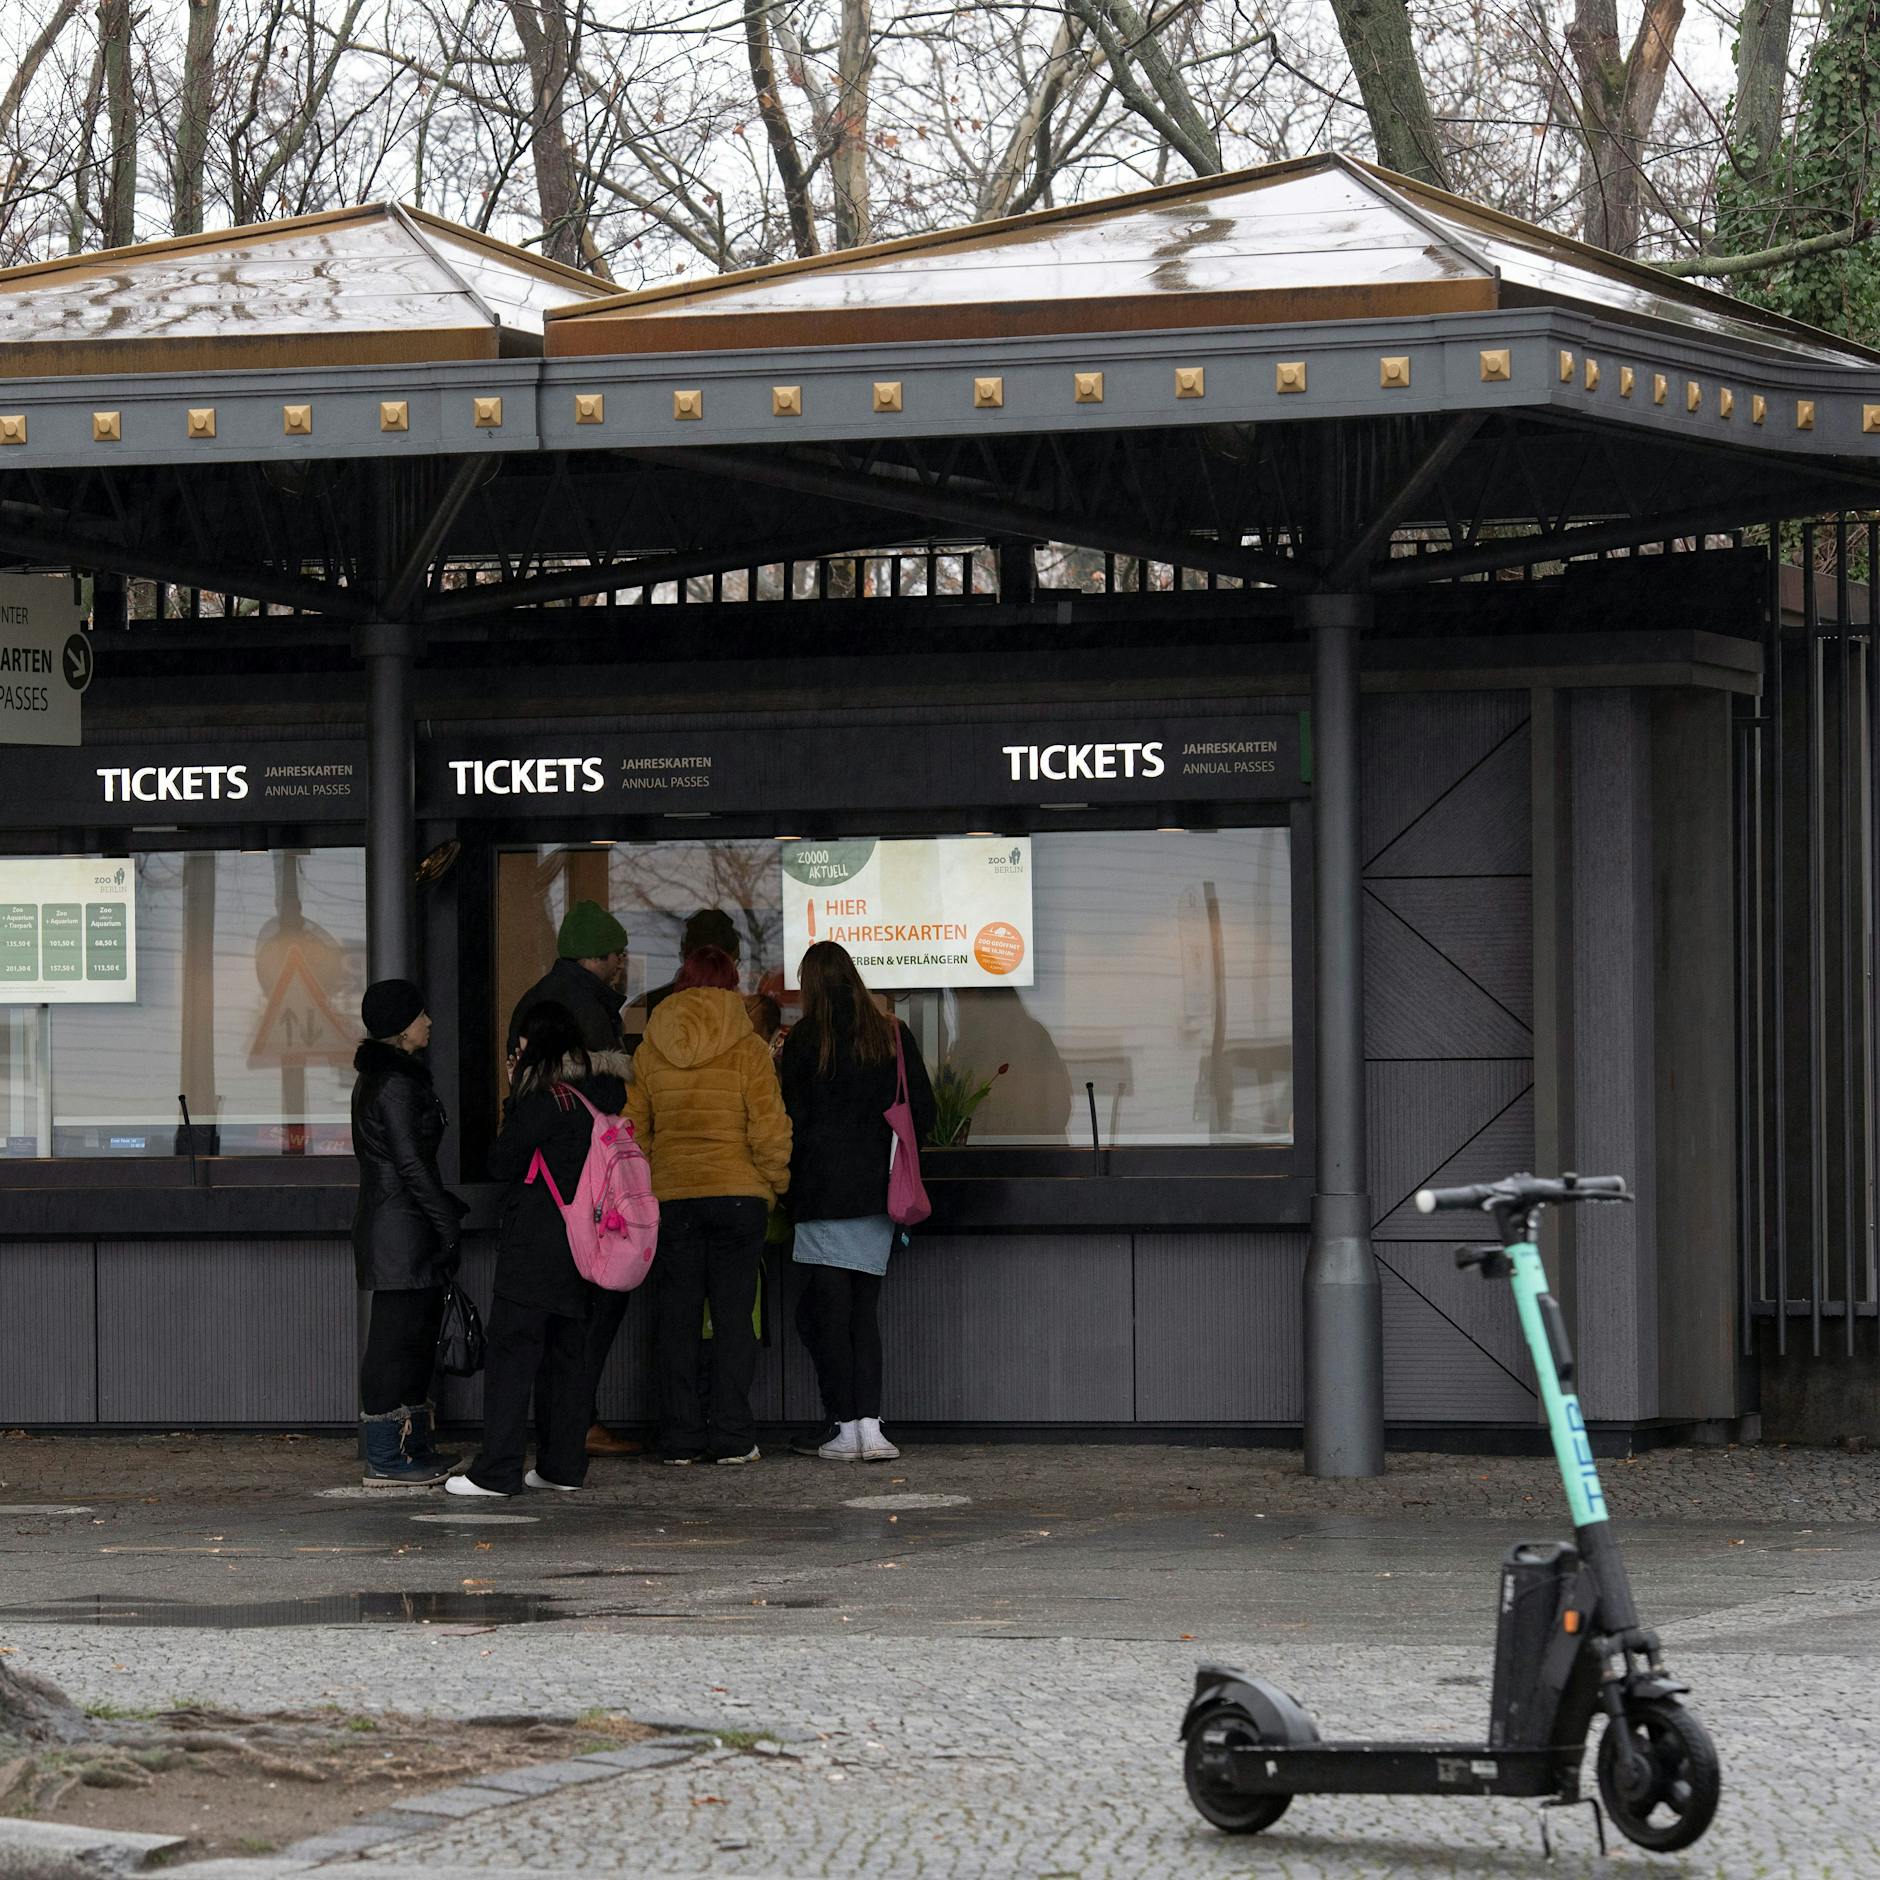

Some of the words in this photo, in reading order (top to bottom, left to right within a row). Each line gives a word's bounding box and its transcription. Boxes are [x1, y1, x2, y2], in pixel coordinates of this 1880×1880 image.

[0, 606, 29, 624] NTER
[0, 647, 52, 673] ARTEN
[1182, 741, 1278, 755] JAHRESKARTEN
[621, 757, 712, 770] JAHRESKARTEN
[1002, 742, 1165, 780] TICKETS
[1183, 763, 1231, 775] ANNUAL
[1234, 761, 1276, 773] PASSES
[265, 765, 353, 777] JAHRESKARTEN
[448, 757, 605, 795] TICKETS
[96, 765, 249, 801] TICKETS
[621, 778, 668, 789] ANNUAL
[671, 776, 710, 787] PASSES
[265, 785, 310, 796] ANNUAL
[312, 784, 351, 795] PASSES
[797, 850, 829, 865] ZOOOO
[809, 864, 849, 879] AKTUELL
[994, 866, 1024, 874] BERLIN
[99, 906, 113, 914] Zoo
[826, 900, 867, 915] HIER
[829, 924, 967, 942] JAHRESKARTEN
[852, 955, 884, 965] ERBEN
[886, 955, 895, 965] &
[897, 954, 968, 965] VERLÄNGERN
